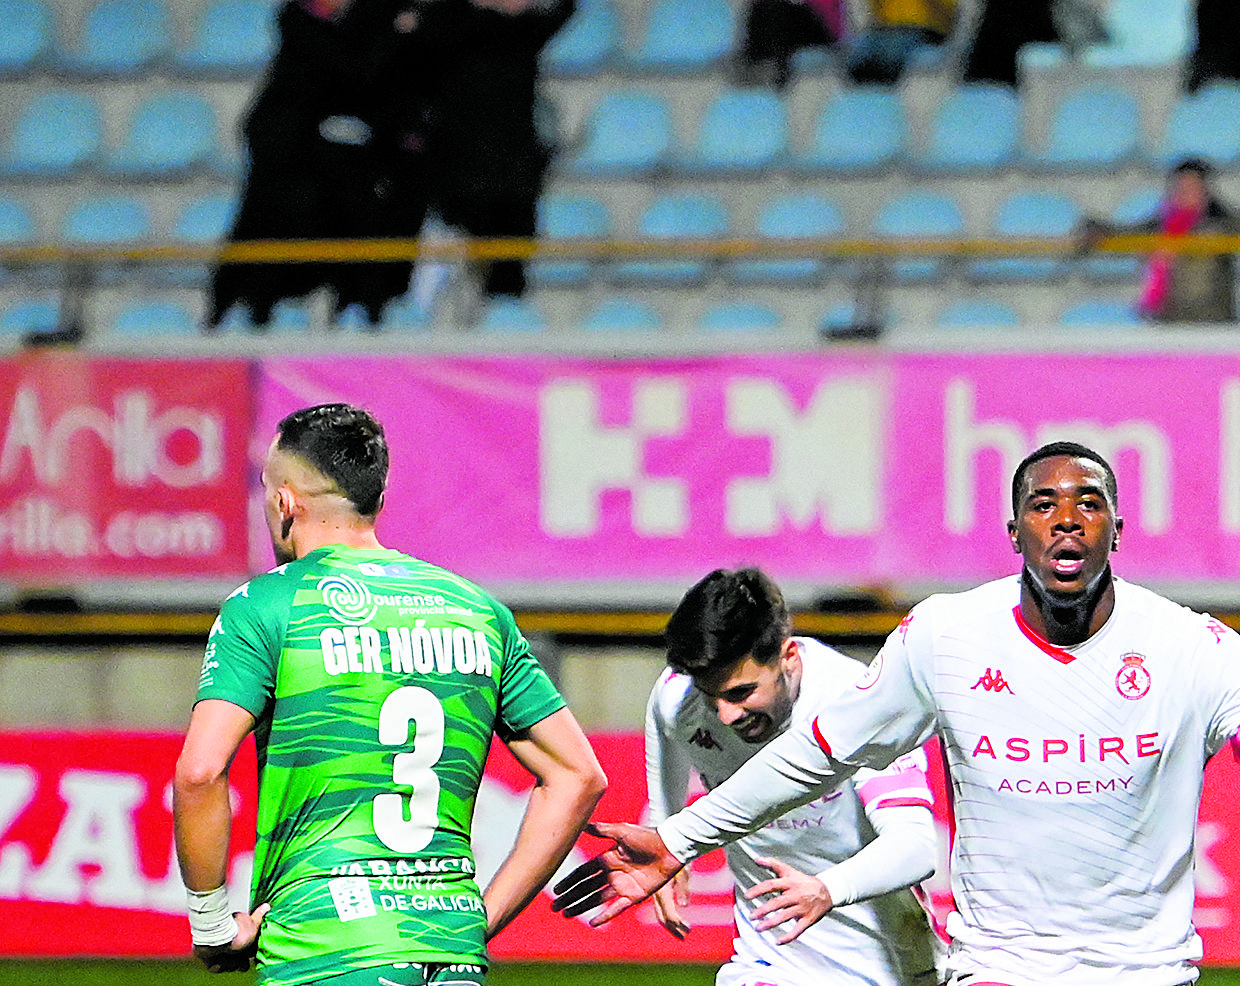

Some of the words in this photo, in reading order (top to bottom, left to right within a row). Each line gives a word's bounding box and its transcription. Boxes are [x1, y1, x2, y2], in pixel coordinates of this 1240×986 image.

[372, 594, 446, 606] ourense
[398, 605, 444, 616] provincia
[319, 626, 384, 676] GER
[387, 619, 492, 677] NÓVOA
[372, 685, 446, 854] 3
[997, 775, 1135, 796] ACADEMY
[379, 894, 409, 912] DE
[411, 895, 485, 914] GALICIA
